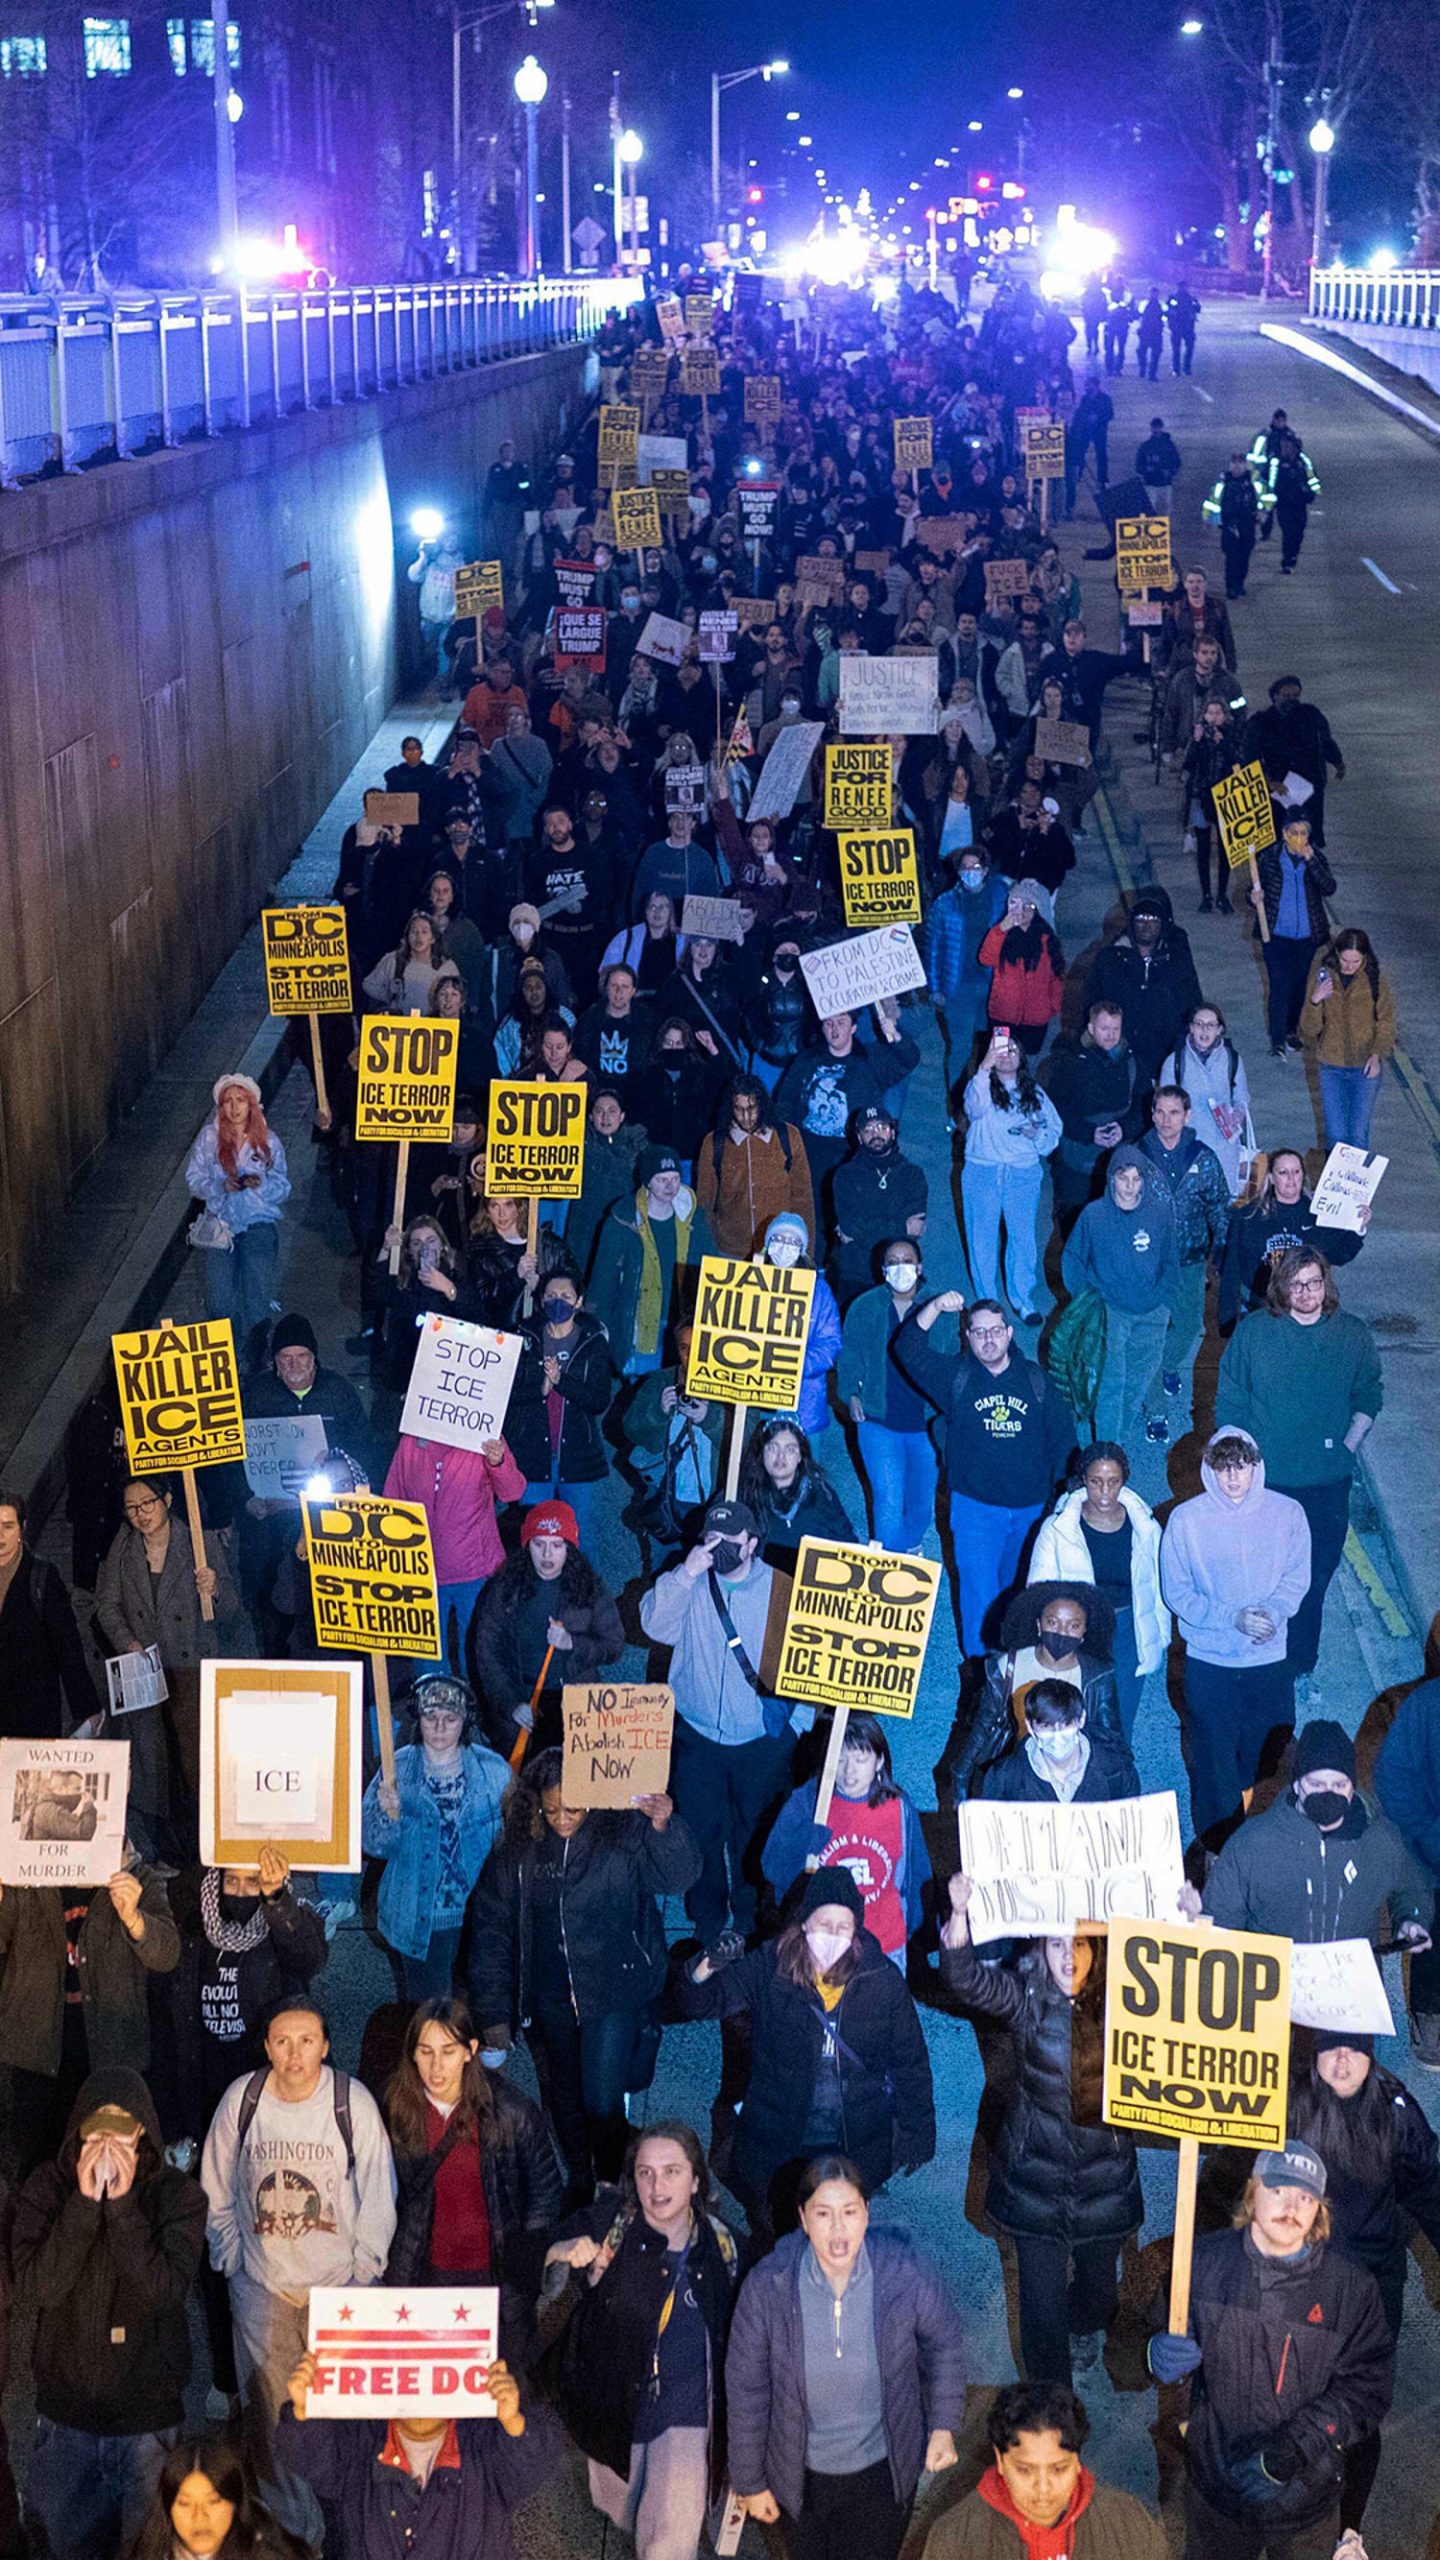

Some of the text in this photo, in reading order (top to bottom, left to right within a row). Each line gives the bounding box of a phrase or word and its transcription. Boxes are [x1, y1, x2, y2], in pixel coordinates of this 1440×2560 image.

[1029, 427, 1063, 442] DC
[652, 470, 688, 482] DC
[619, 491, 655, 508] JUSTICE
[739, 490, 778, 502] TRUMP
[618, 508, 655, 519] FOR
[742, 502, 774, 514] MUST
[749, 512, 767, 524] GO
[743, 523, 774, 536] NOW!
[1120, 521, 1168, 540] DC
[1120, 539, 1169, 551] MINNEAPOLIS
[989, 562, 1022, 576] FUCK
[1121, 554, 1169, 564] STOP
[456, 564, 499, 581] DC
[554, 569, 595, 585] TRUMP
[1121, 564, 1169, 578] ICE TERROR
[559, 582, 591, 597] MUST
[991, 577, 1026, 594] ICE
[587, 613, 602, 626] SE
[558, 627, 602, 640] LARGUE
[560, 640, 600, 652] TRUMP
[851, 661, 921, 687] JUSTICE
[832, 749, 889, 770] JUSTICE
[665, 772, 704, 781] RENEE
[831, 771, 887, 785] FOR
[1216, 767, 1261, 801] JAIL
[831, 787, 886, 807] RENEE
[1218, 779, 1268, 826] KILLER
[829, 806, 887, 818] GOOD
[1226, 804, 1272, 845] ICE
[1229, 821, 1273, 855] AGENTS
[845, 837, 911, 877] STOP
[546, 870, 585, 885] HATE
[845, 880, 916, 900] ICE TERROR
[685, 897, 741, 918] ABOLISH
[851, 898, 914, 913] NOW
[266, 912, 344, 942] DC
[267, 940, 345, 960] MINNEAPOLIS
[821, 931, 892, 971] FROM DC
[270, 964, 348, 980] STOP
[816, 946, 918, 993] TO PALESTINE
[889, 966, 920, 990] CRIME
[271, 979, 349, 1000] ICE TERROR
[366, 1026, 453, 1076] STOP
[599, 1058, 628, 1074] NO
[361, 1083, 451, 1107] ICE TERROR
[364, 1108, 446, 1124] NOW
[496, 1091, 581, 1137] STOP
[490, 1144, 579, 1166] ICE TERROR
[495, 1166, 575, 1182] NOW
[705, 1262, 809, 1297] JAIL
[700, 1286, 808, 1339] KILLER
[119, 1325, 228, 1361] JAIL
[697, 1331, 801, 1376] ICE
[435, 1338, 502, 1370] STOP
[122, 1350, 233, 1403] KILLER
[437, 1369, 487, 1401] ICE
[695, 1366, 796, 1391] AGENTS
[130, 1392, 239, 1439] ICE
[418, 1395, 495, 1434] TERROR
[1007, 1395, 1029, 1416] HILL
[983, 1418, 1022, 1432] TIGERS
[135, 1428, 241, 1454] AGENTS
[338, 1502, 391, 1514] FROM
[306, 1500, 427, 1549] DC
[355, 1539, 381, 1549] TO
[311, 1542, 430, 1576] MINNEAPOLIS
[840, 1551, 898, 1569] FROM
[800, 1548, 933, 1606] DC
[315, 1574, 433, 1604] STOP
[850, 1590, 878, 1603] TO
[317, 1598, 436, 1637] ICE TERROR
[794, 1589, 926, 1634] MINNEAPOLIS
[789, 1624, 922, 1660] STOP
[784, 1646, 916, 1695] ICE TERROR
[587, 1688, 618, 1713] NO
[569, 1709, 664, 1731] For Murders
[571, 1728, 671, 1754] Abolish ICE
[28, 1749, 95, 1764] WANTED
[255, 1769, 302, 1793] ICE
[39, 1844, 69, 1857] FOR
[18, 1865, 87, 1878] MURDER
[218, 1967, 239, 1982] THE
[1121, 1936, 1281, 2034] STOP
[1111, 2029, 1280, 2090] ICE TERROR
[1119, 2073, 1271, 2118] NOW
[1112, 2103, 1277, 2142] PARTY FOR SOCIALISM & LIBERATION
[1284, 2152, 1318, 2177] YETI
[312, 2365, 490, 2395] FREE DC
